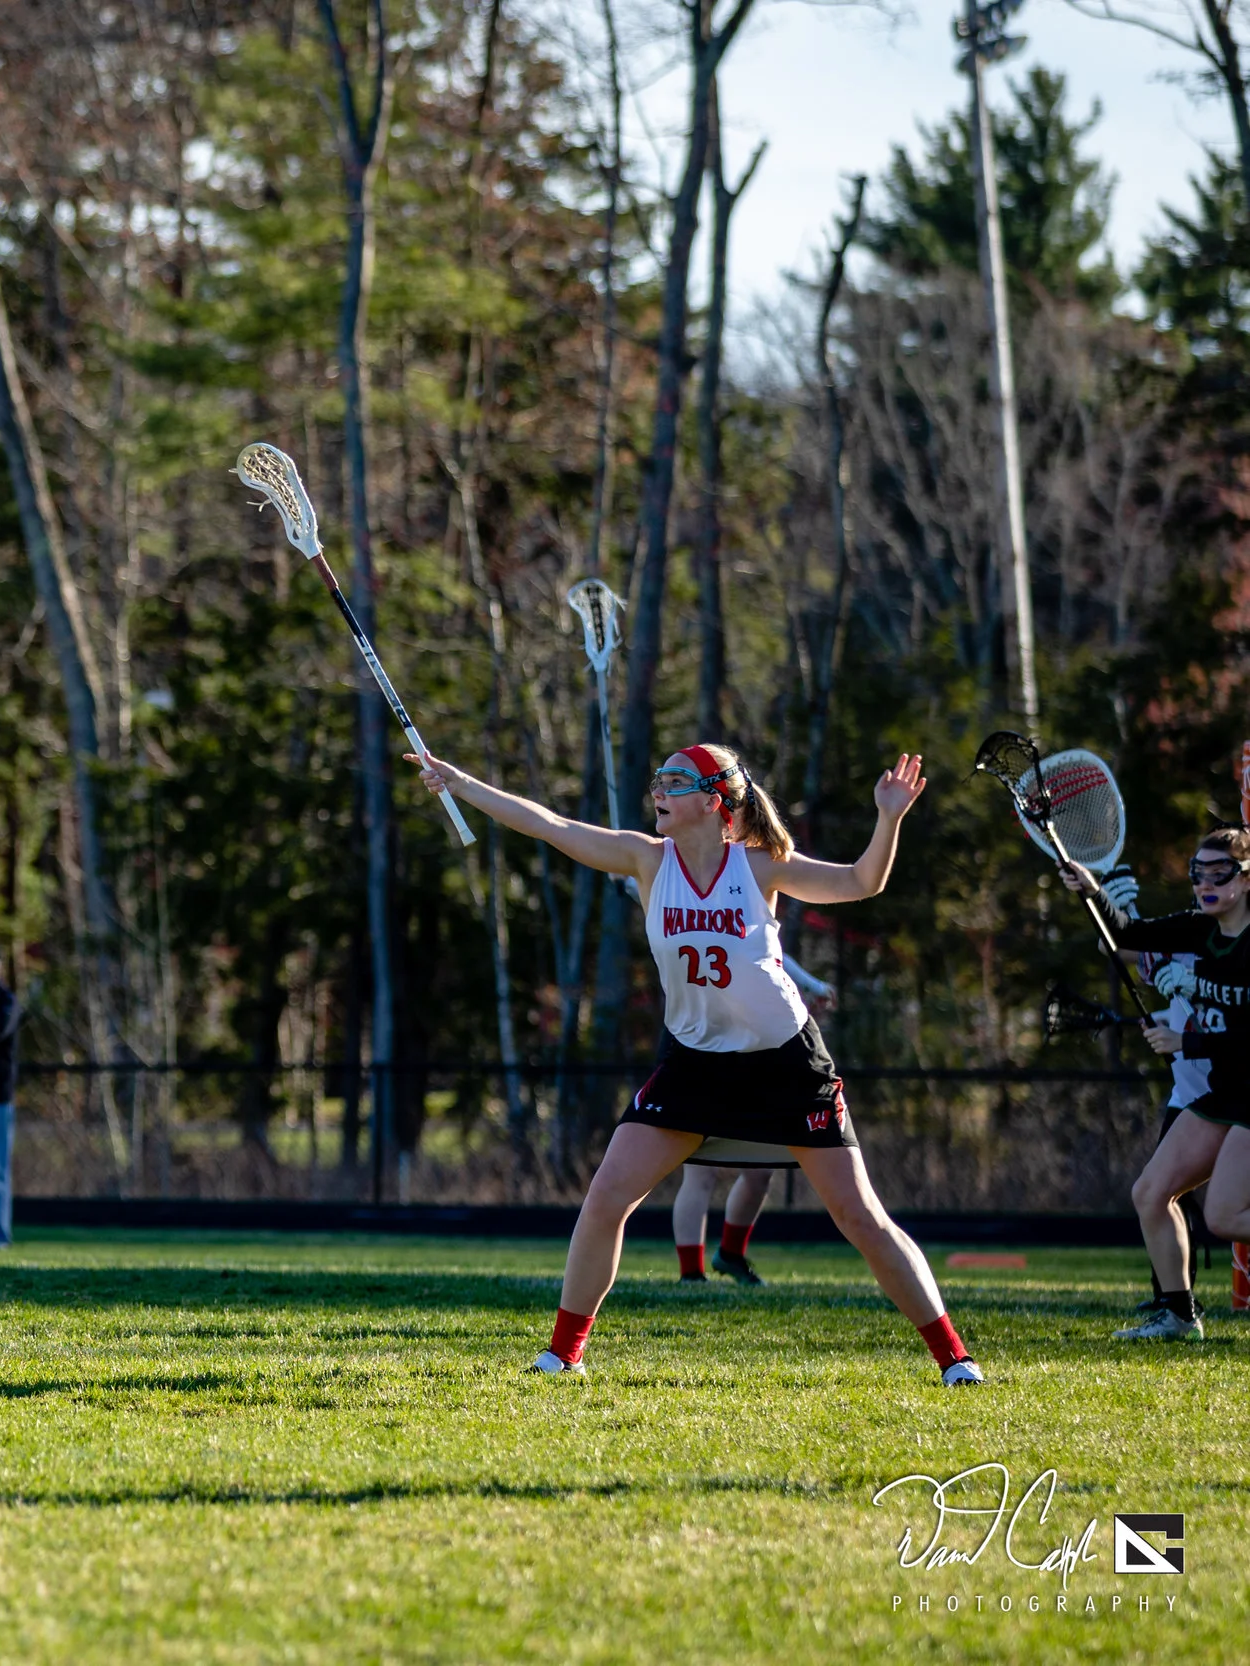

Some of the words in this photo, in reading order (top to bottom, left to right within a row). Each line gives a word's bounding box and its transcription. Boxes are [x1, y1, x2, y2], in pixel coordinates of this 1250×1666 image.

[700, 774, 722, 787] STX
[663, 906, 746, 940] WARRIORS
[678, 945, 732, 989] 23
